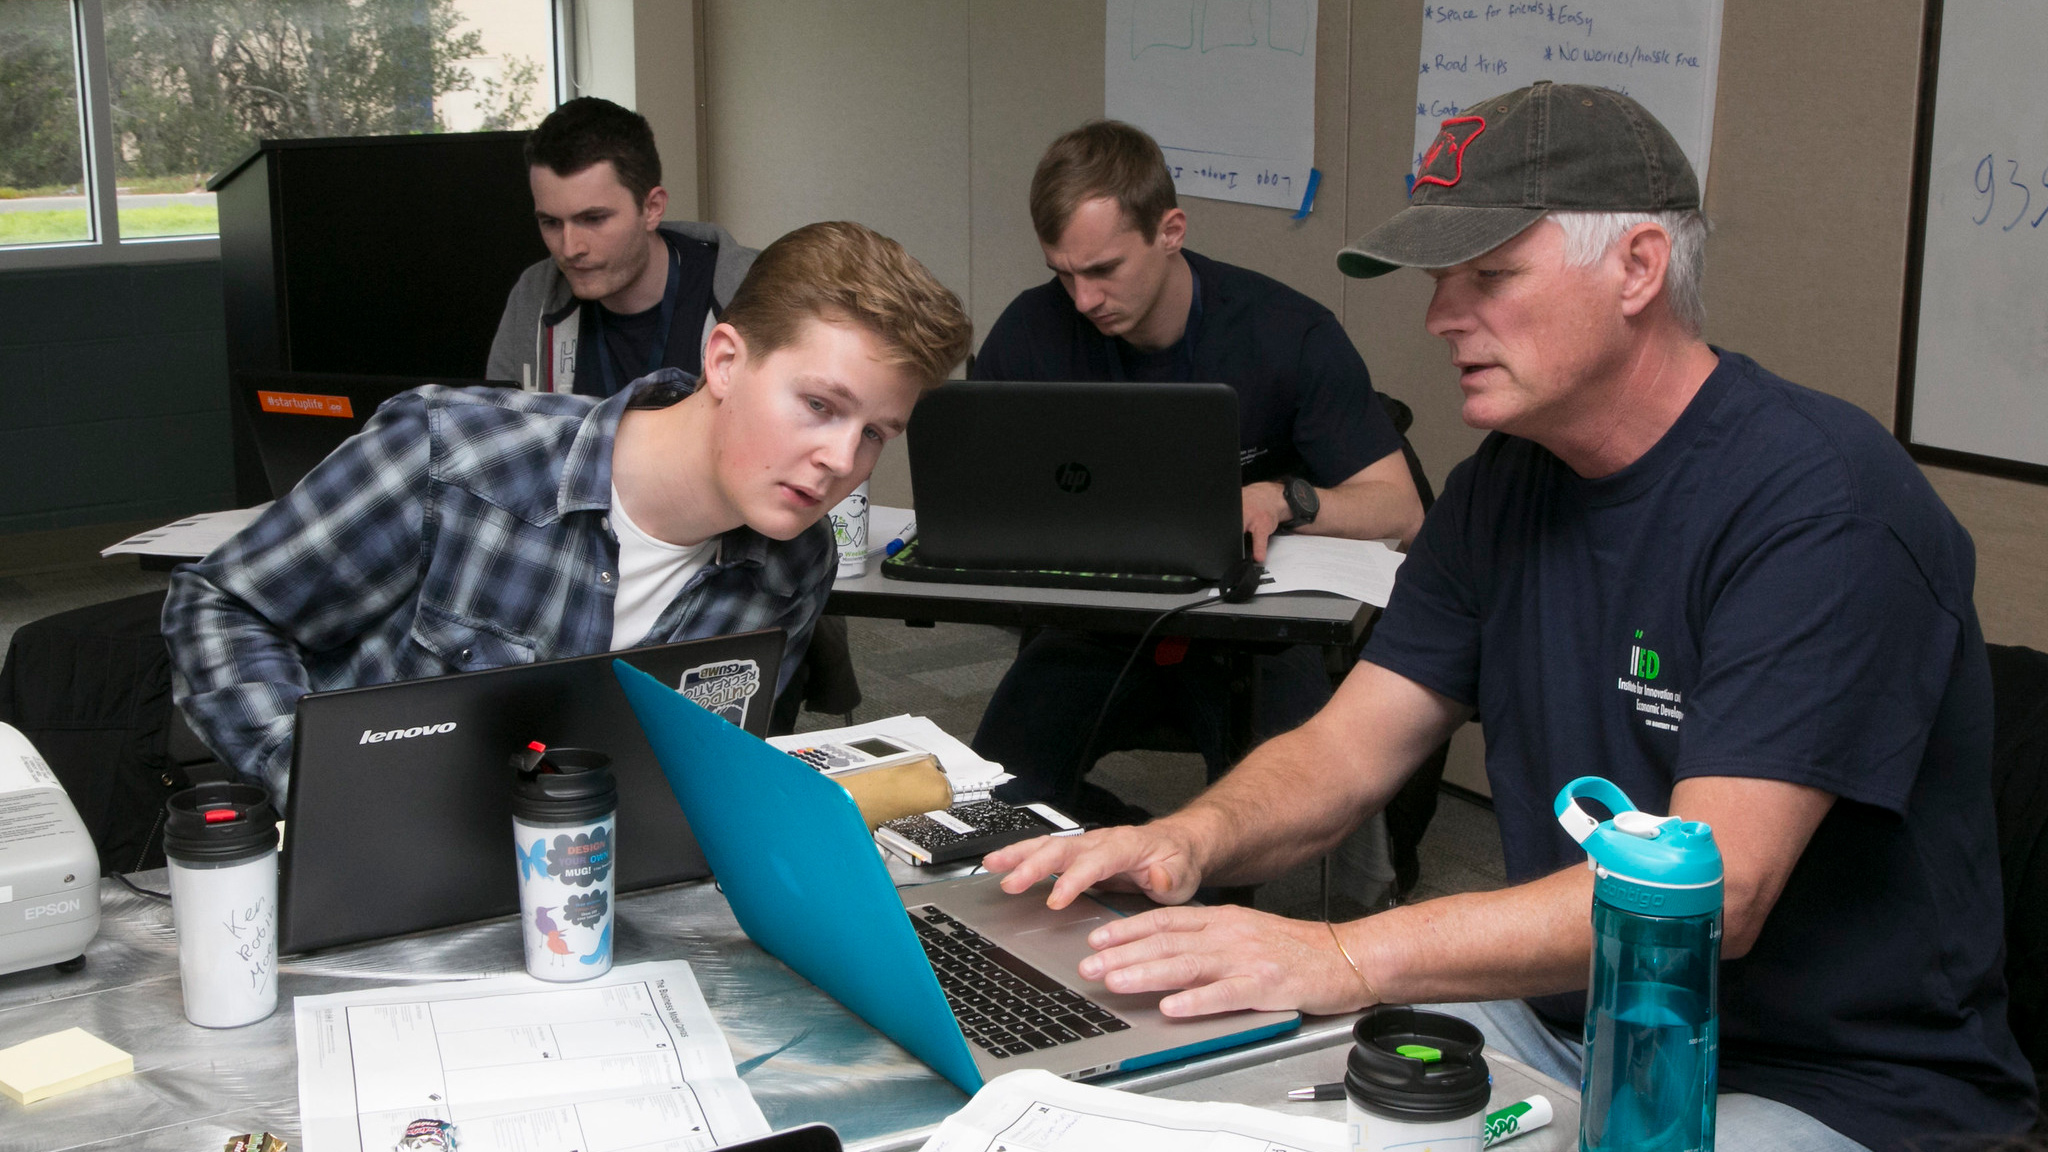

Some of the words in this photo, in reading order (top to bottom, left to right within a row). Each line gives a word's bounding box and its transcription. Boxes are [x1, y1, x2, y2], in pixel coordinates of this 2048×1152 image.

[1437, 8, 1478, 23] Space
[1485, 8, 1502, 21] for
[1508, 1, 1545, 16] friends
[1434, 54, 1468, 73] Road
[1475, 54, 1508, 74] trips
[267, 396, 323, 410] #startuplife
[701, 664, 740, 678] CSUMB
[684, 670, 757, 700] RECREATIO
[697, 682, 757, 709] OUTDO
[1643, 684, 1674, 702] Innovation
[1660, 703, 1684, 722] Develop
[359, 721, 457, 745] lenovo
[567, 841, 607, 856] DESIGN
[558, 855, 587, 868] YOUR
[589, 852, 609, 866] OWN
[565, 865, 592, 877] MUG!
[1601, 881, 1665, 908] contigo
[24, 899, 81, 921] EPSON
[223, 896, 265, 939] Ken
[659, 988, 674, 1011] Business
